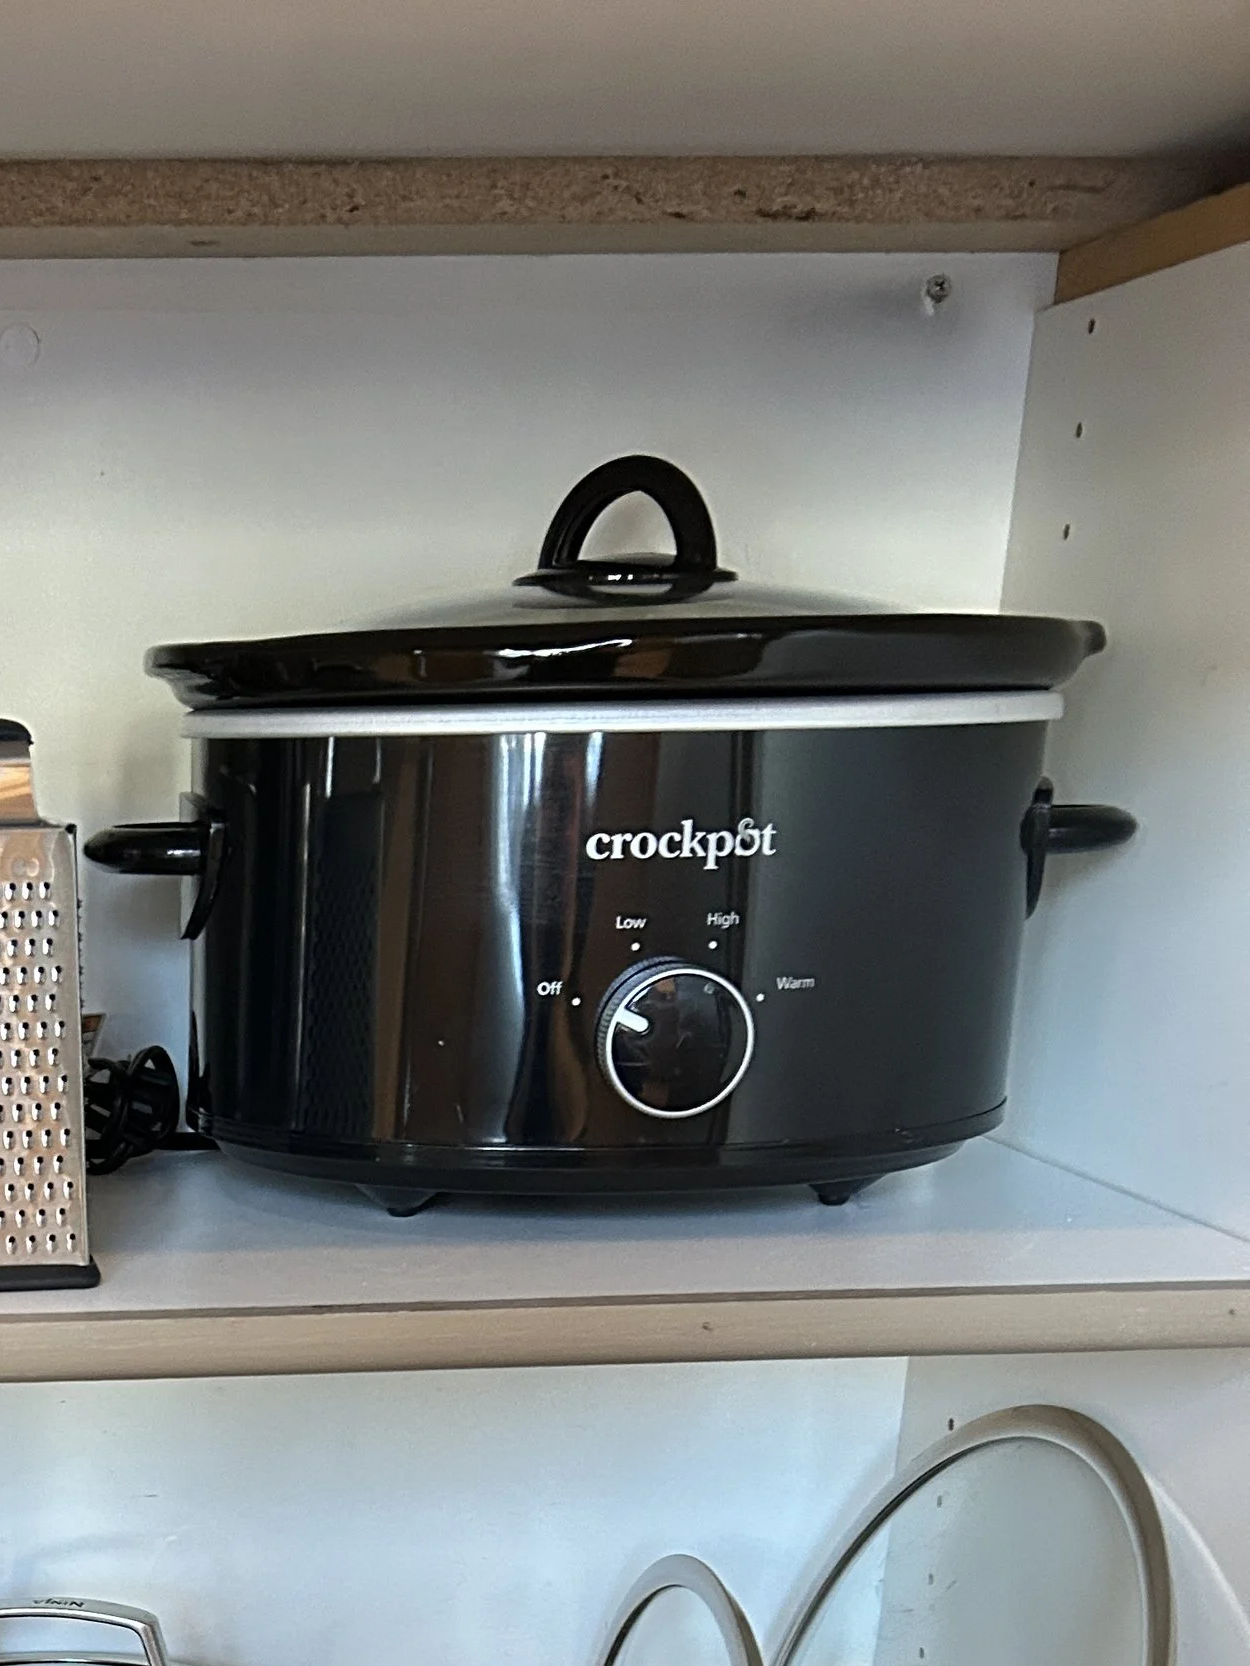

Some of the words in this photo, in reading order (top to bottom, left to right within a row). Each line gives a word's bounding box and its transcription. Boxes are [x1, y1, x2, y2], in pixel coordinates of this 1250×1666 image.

[585, 817, 777, 870] crockpot
[615, 915, 647, 930] Low
[706, 912, 740, 928] High
[536, 981, 563, 996] Off
[776, 976, 816, 991] Warm
